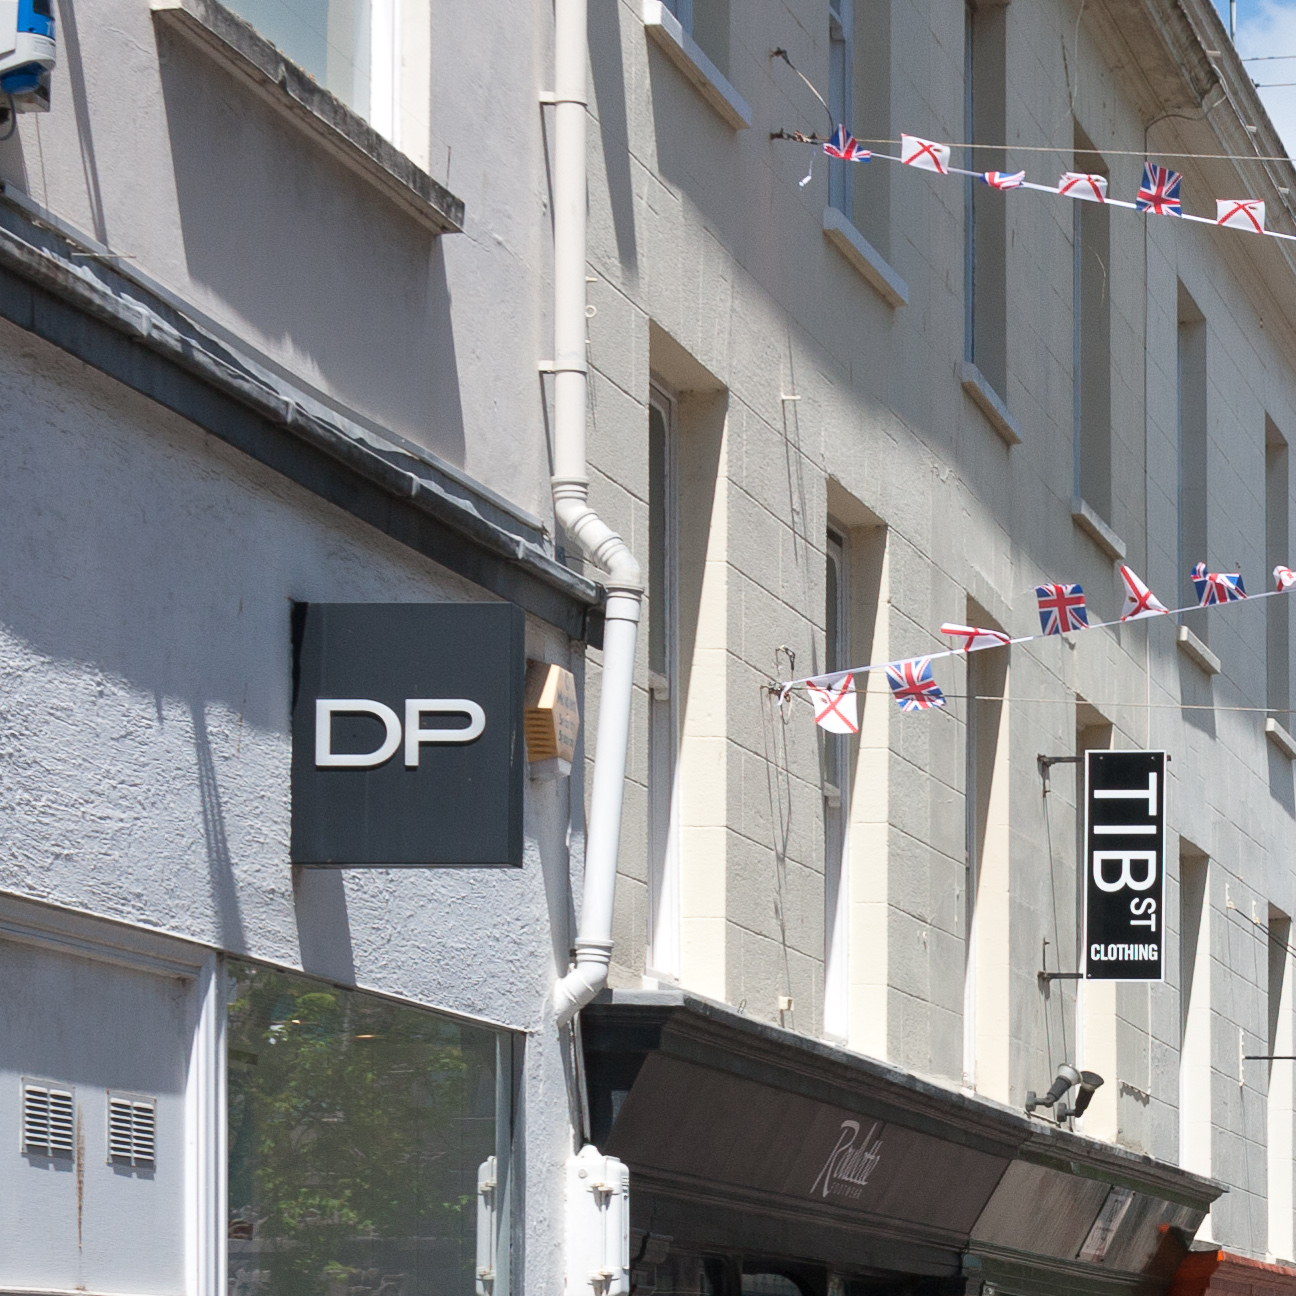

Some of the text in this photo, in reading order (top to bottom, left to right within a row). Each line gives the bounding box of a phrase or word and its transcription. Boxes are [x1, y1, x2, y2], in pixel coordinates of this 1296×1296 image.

[315, 699, 486, 767] DP
[1092, 771, 1158, 932] TIB ST
[1090, 944, 1159, 961] CLOTHING
